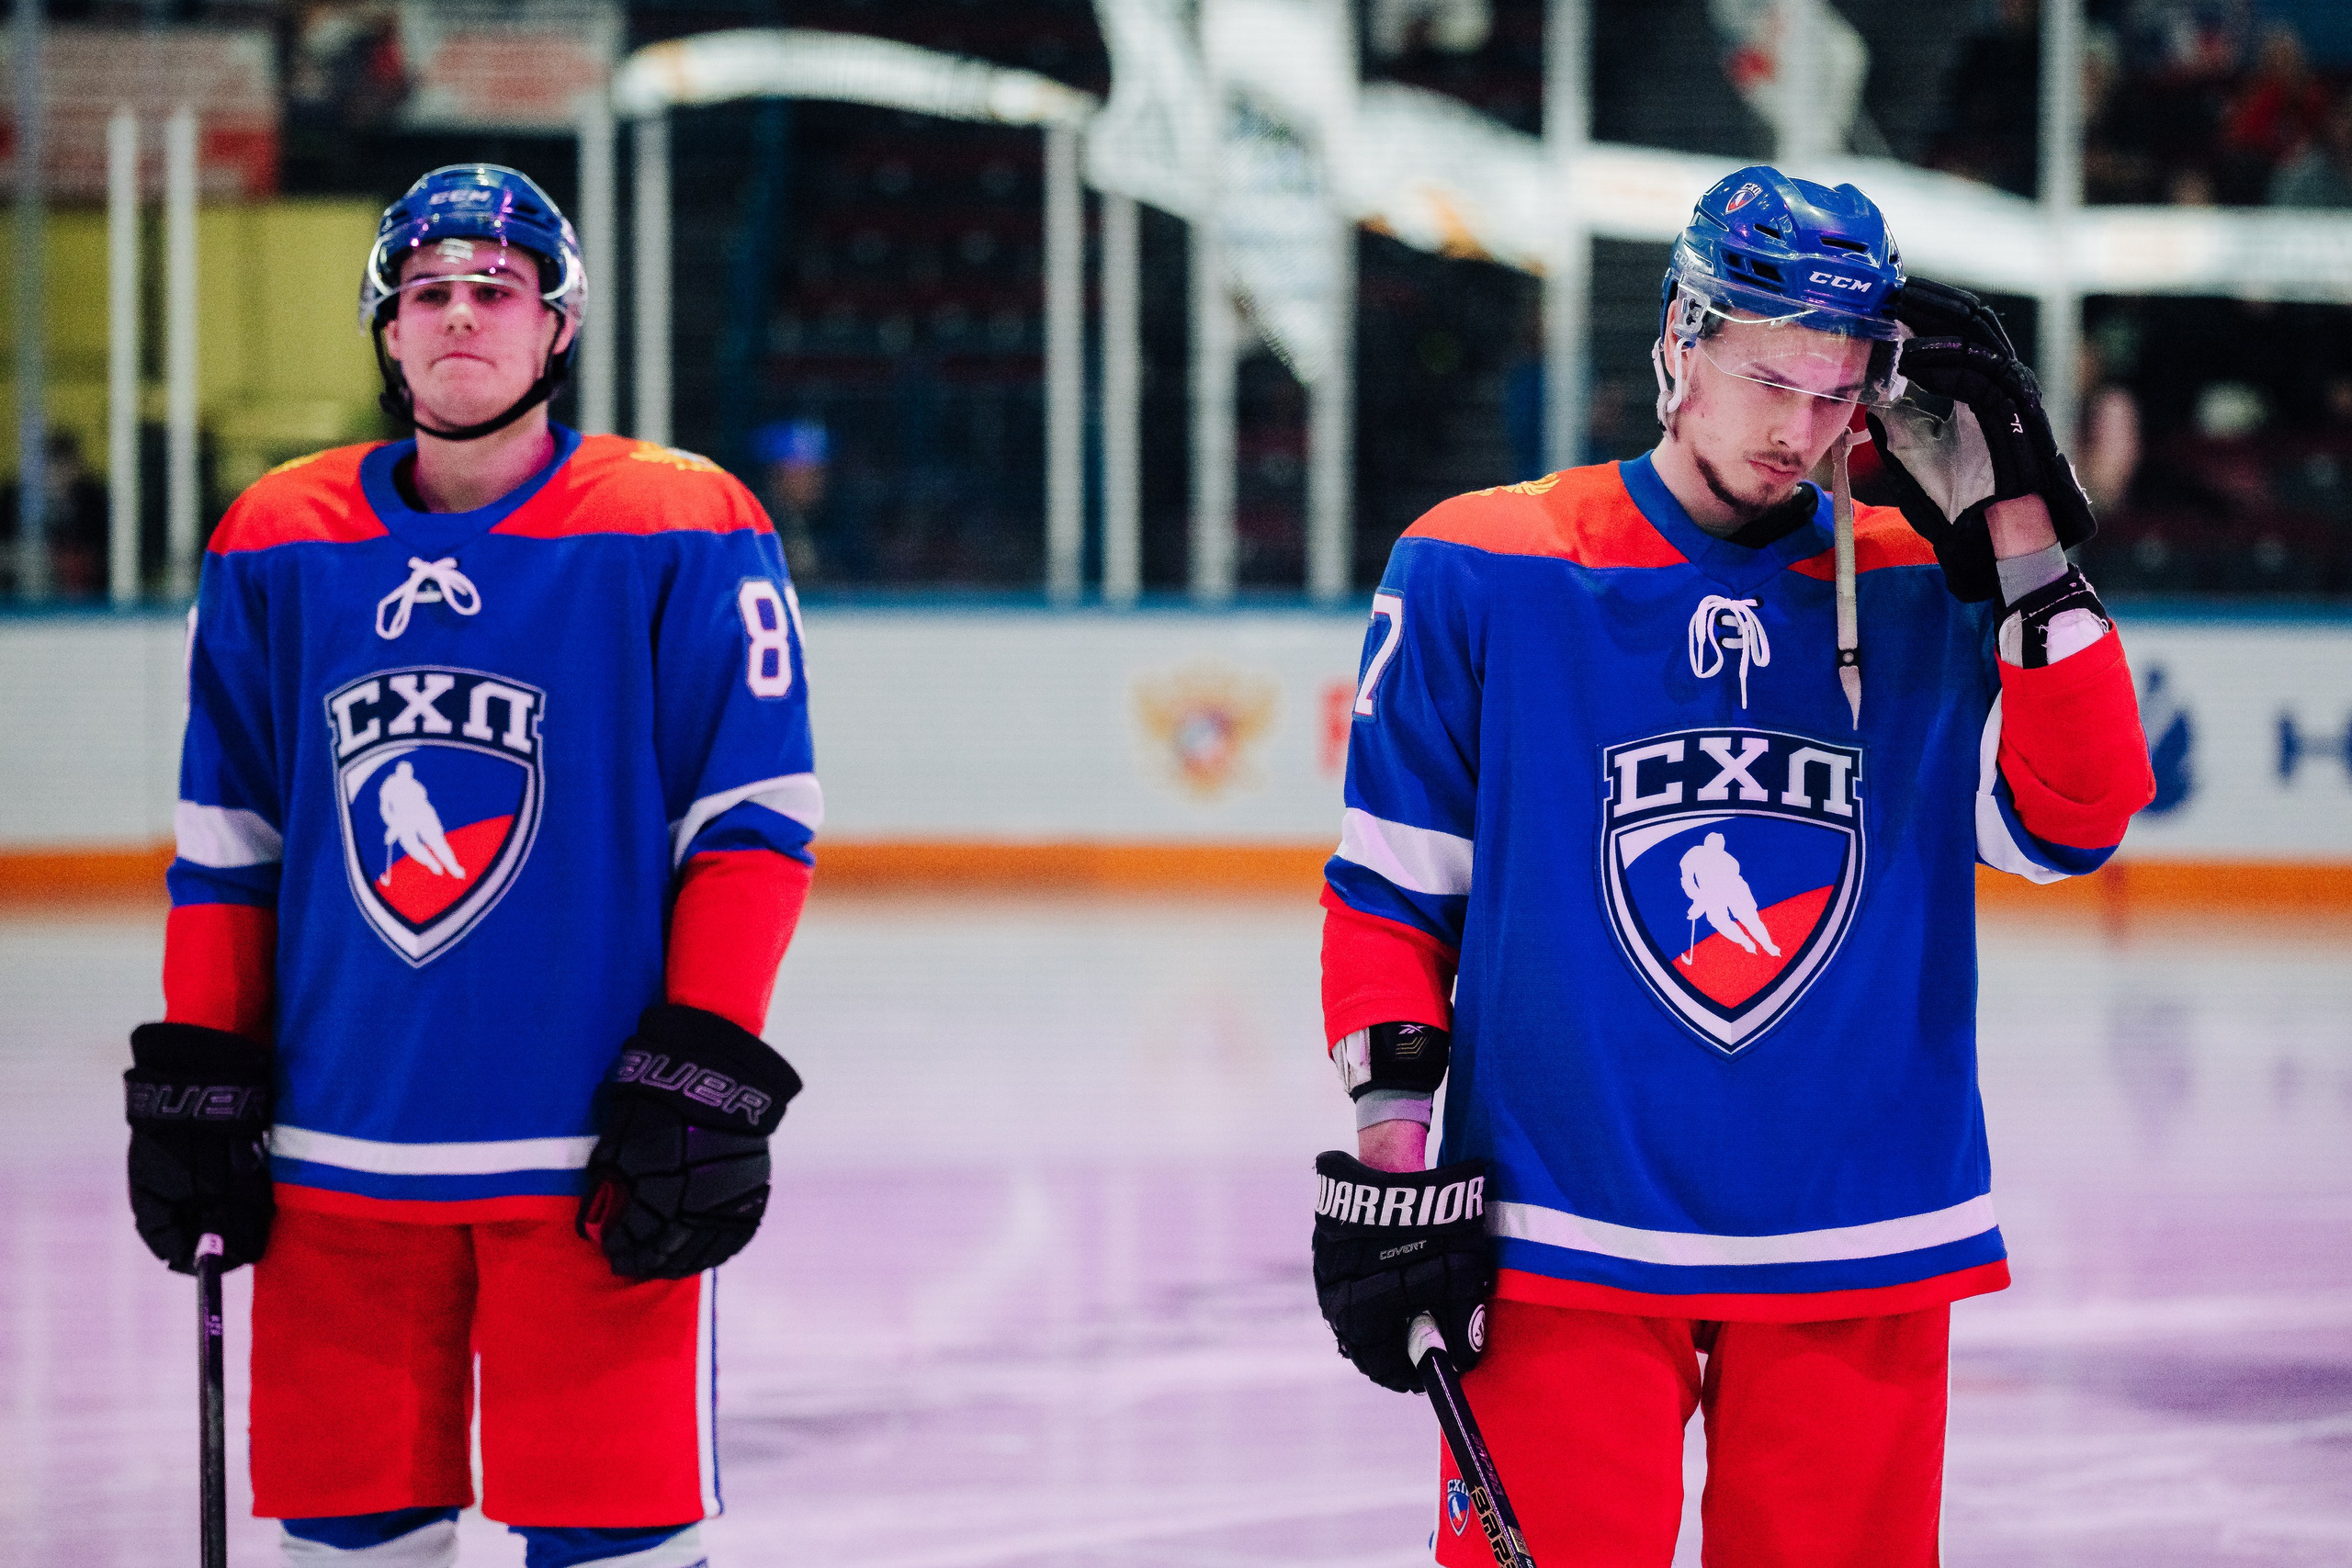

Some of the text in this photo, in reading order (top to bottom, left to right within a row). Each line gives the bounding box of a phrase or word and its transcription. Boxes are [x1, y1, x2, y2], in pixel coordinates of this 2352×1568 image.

[1808, 271, 1873, 294] CCM
[738, 581, 806, 697] 8
[332, 673, 536, 759] СХП
[1613, 738, 1853, 818] СХП
[128, 1082, 267, 1122] AUER
[618, 1048, 774, 1127] AUER
[1316, 1175, 1485, 1226] WARRIOR
[1379, 1239, 1428, 1260] COVERT
